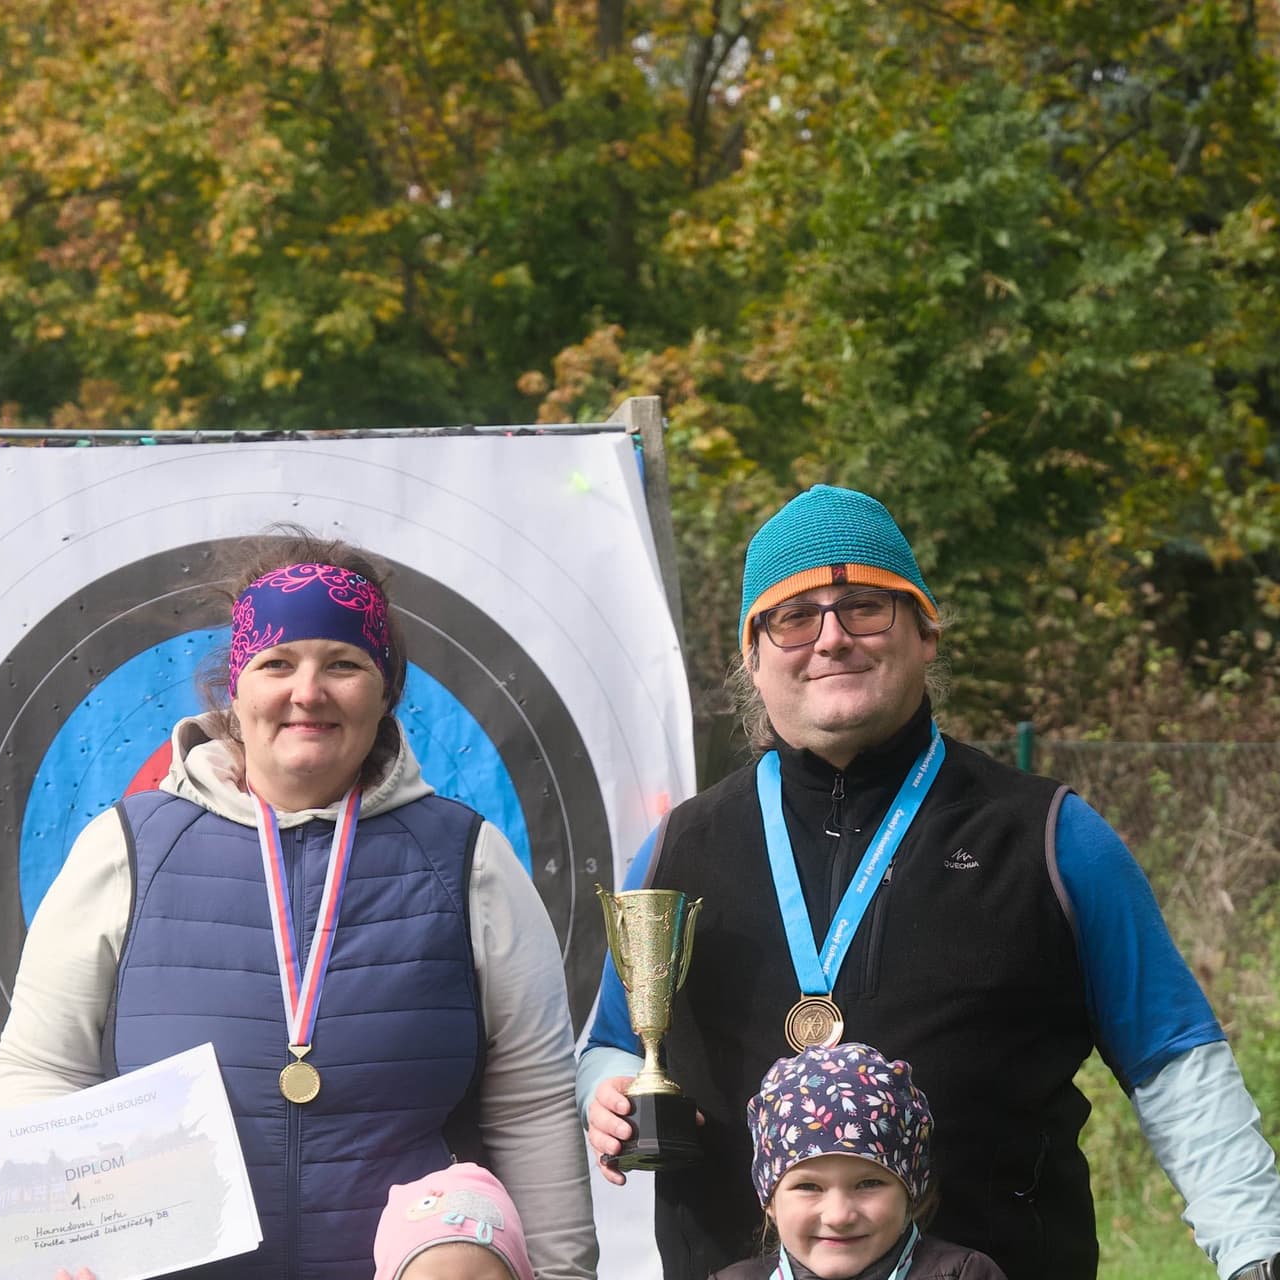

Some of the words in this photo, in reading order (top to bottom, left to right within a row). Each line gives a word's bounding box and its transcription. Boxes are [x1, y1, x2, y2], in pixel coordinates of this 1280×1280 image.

[545, 858, 558, 874] 4
[585, 857, 598, 873] 3
[944, 860, 979, 869] QUECHUA
[117, 1091, 158, 1111] BOUSOV
[65, 1155, 126, 1182] DIPLOM
